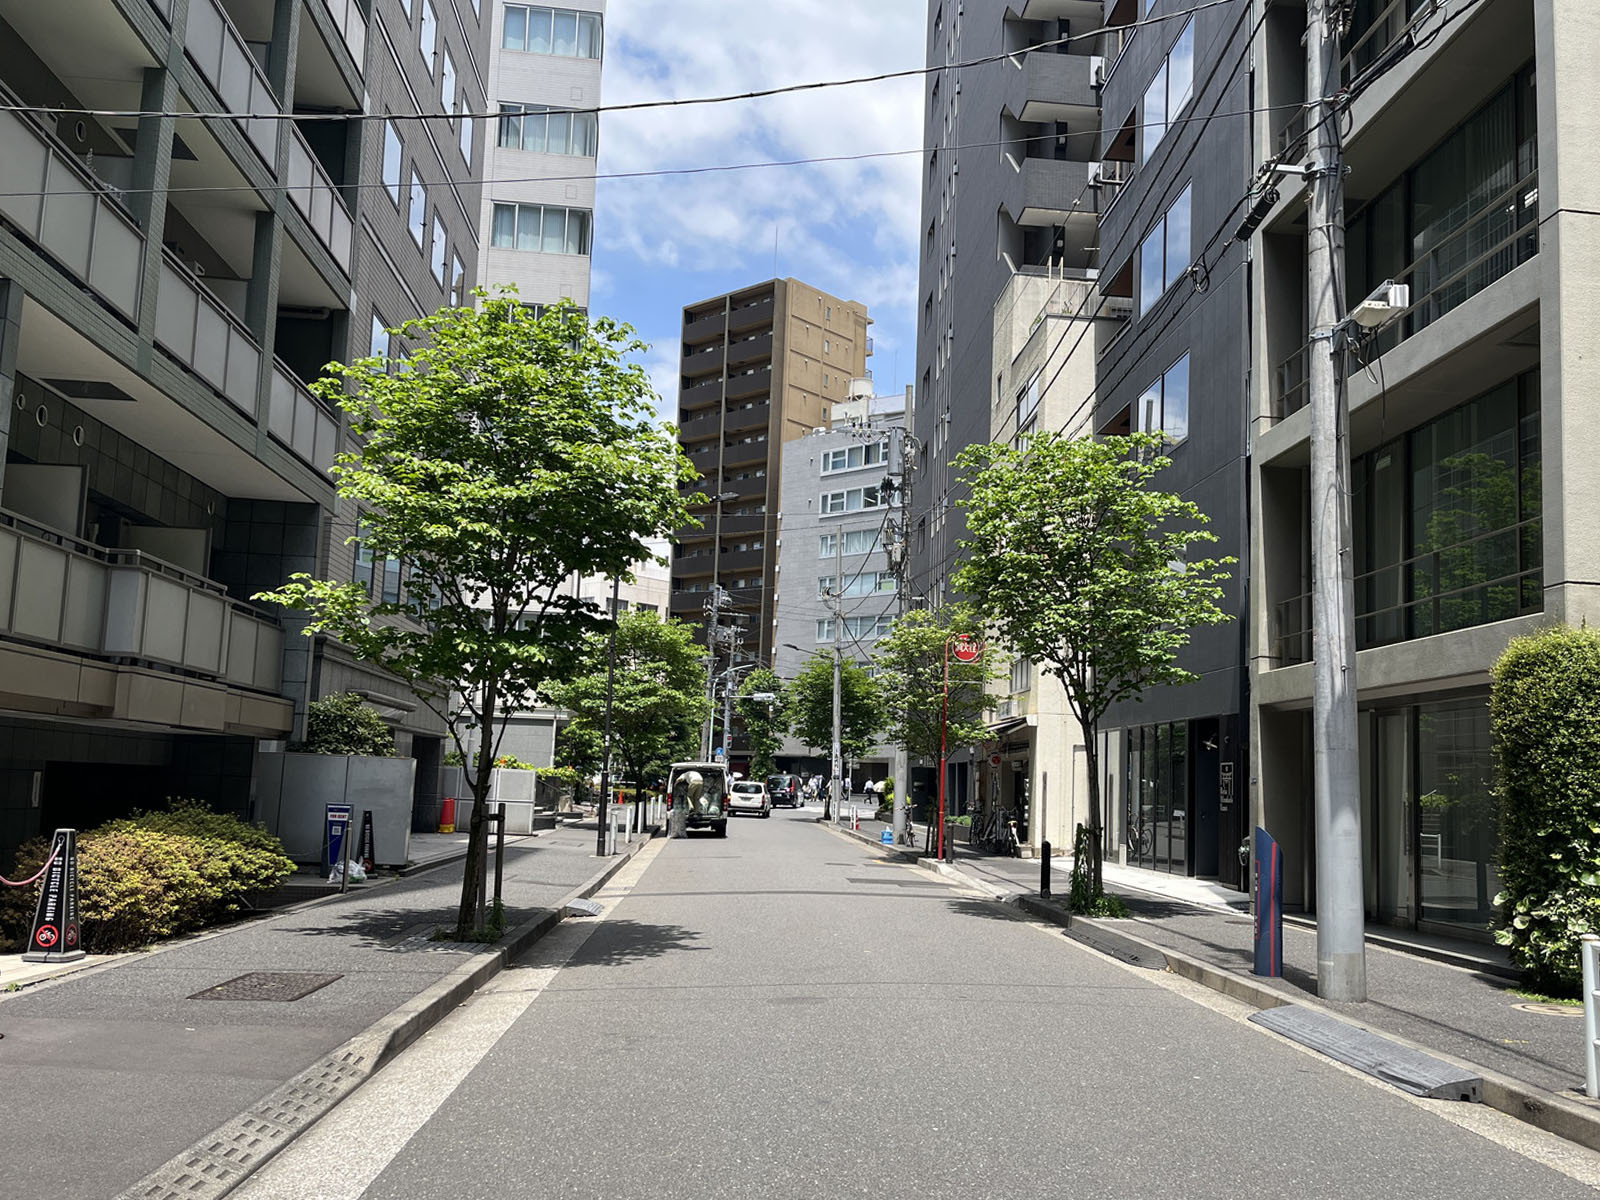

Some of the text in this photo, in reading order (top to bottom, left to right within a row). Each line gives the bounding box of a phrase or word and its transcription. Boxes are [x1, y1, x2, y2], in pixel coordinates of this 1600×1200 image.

[45, 856, 63, 921] NO BICYCLE PARKING
